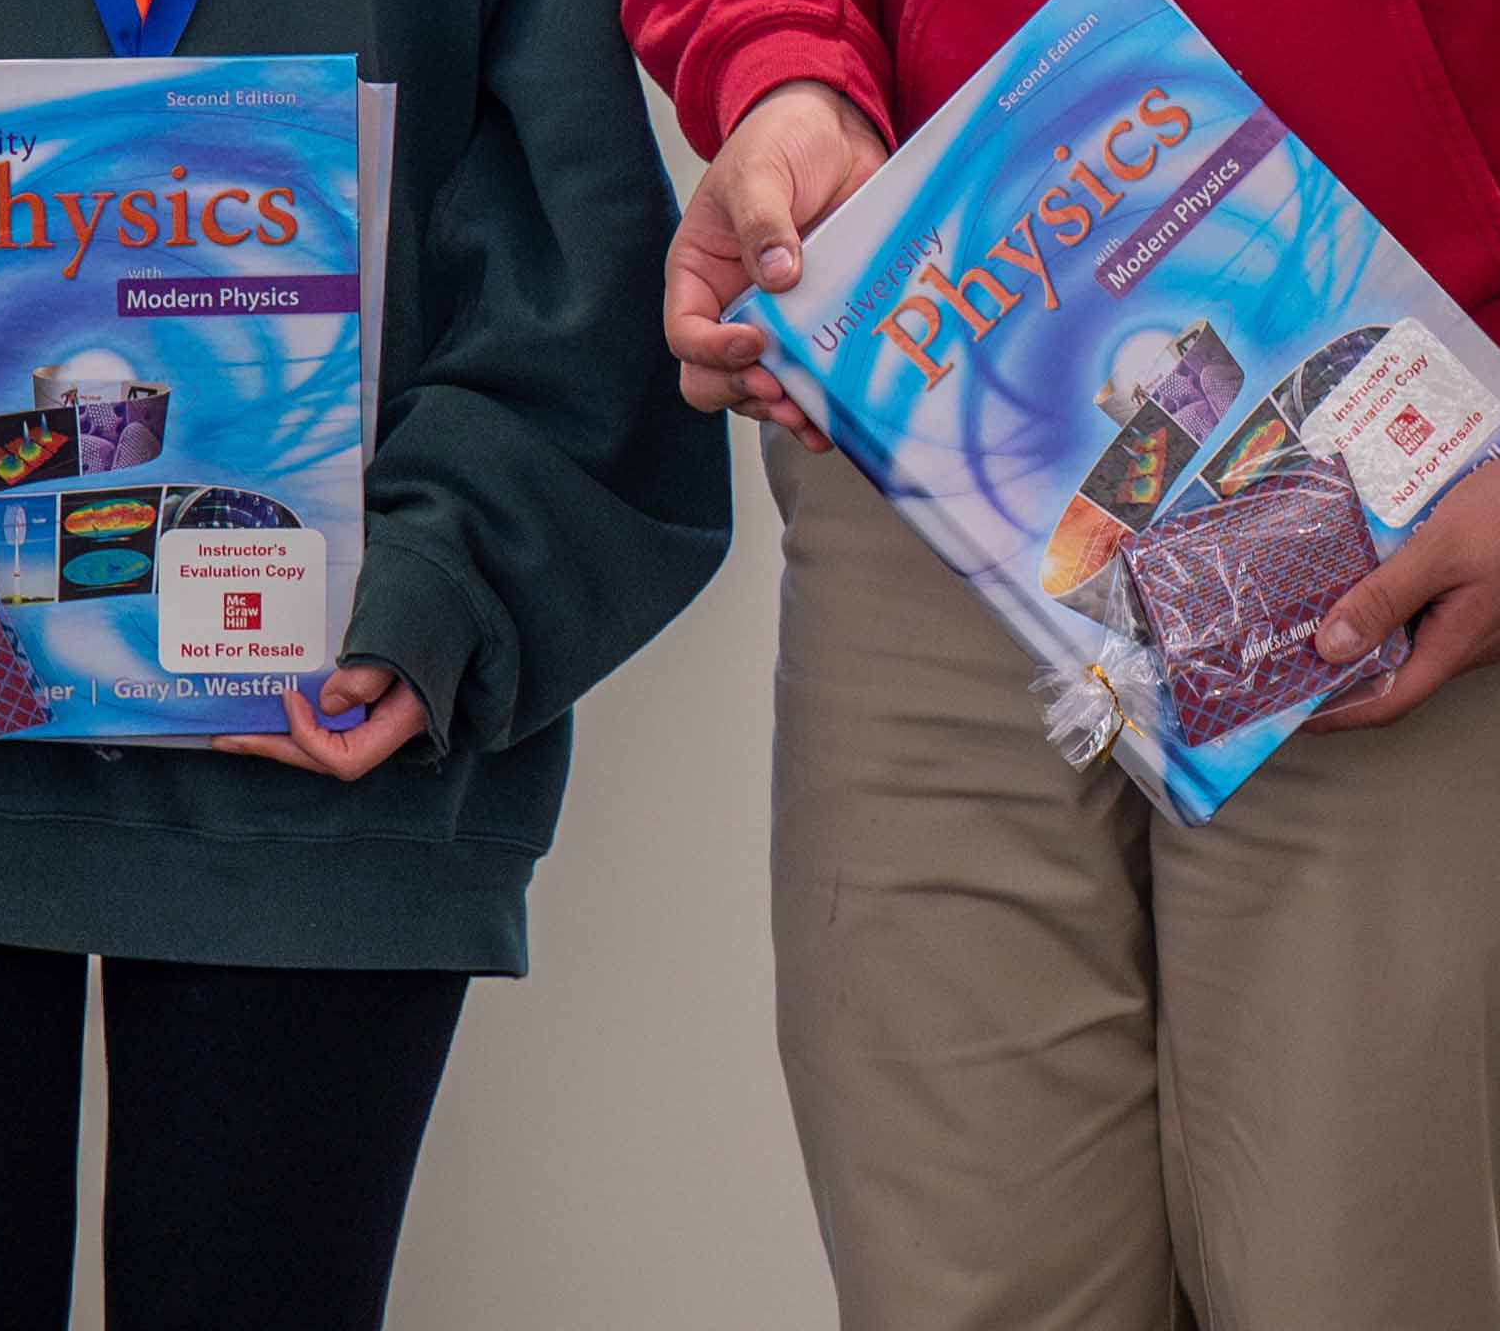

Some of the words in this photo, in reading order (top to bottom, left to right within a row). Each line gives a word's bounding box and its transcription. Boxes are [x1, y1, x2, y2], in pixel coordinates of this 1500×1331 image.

[997, 57, 1051, 113] Second
[1046, 11, 1100, 64] Edition
[165, 91, 231, 108] Second
[234, 90, 297, 107] Edition
[1106, 219, 1180, 291] Modern
[1173, 156, 1241, 224] Physics
[871, 86, 1192, 392] Physics
[1093, 235, 1122, 268] with
[126, 265, 163, 281] with
[126, 287, 213, 310] Modern
[218, 286, 300, 309] Physics
[811, 224, 946, 353] University
[1331, 353, 1401, 423] Instructor's
[1333, 385, 1398, 453] Evaluation
[1394, 353, 1430, 388] Copy
[1391, 480, 1419, 507] Not
[1415, 456, 1443, 484] For
[1439, 410, 1485, 458] Resale
[197, 543, 287, 557] Instructor's
[179, 564, 260, 578] Evaluation
[265, 564, 306, 581] Copy
[225, 594, 247, 606] Mc
[225, 606, 260, 618] Graw
[225, 617, 248, 629] Hill
[180, 643, 209, 658] Not
[215, 643, 243, 658] For
[248, 643, 305, 658] Resale
[113, 677, 171, 703] Gary
[175, 677, 200, 697] D.
[203, 673, 299, 697] Westfall
